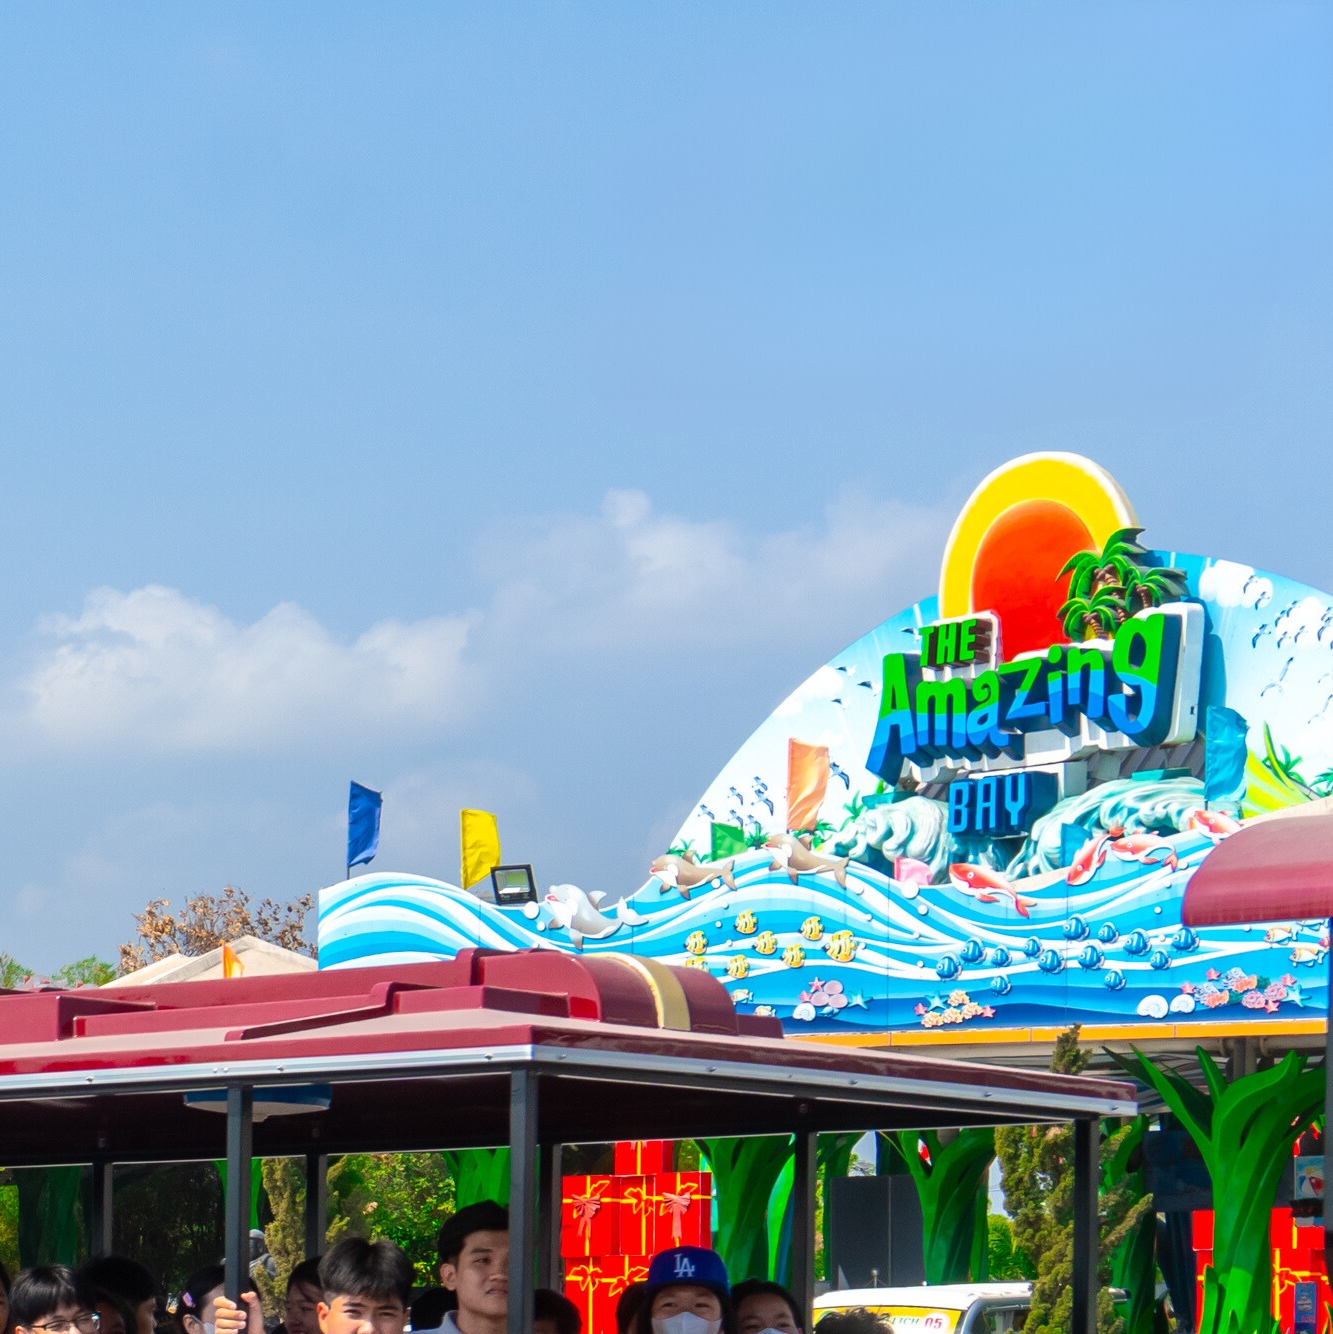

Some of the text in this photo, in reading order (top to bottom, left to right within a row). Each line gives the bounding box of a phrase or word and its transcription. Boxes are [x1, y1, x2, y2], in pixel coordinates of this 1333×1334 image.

[918, 618, 977, 667] THE
[865, 612, 1166, 779] Amazing
[947, 772, 1027, 834] BAY
[673, 1253, 695, 1278] LA
[924, 1317, 943, 1330] 05
